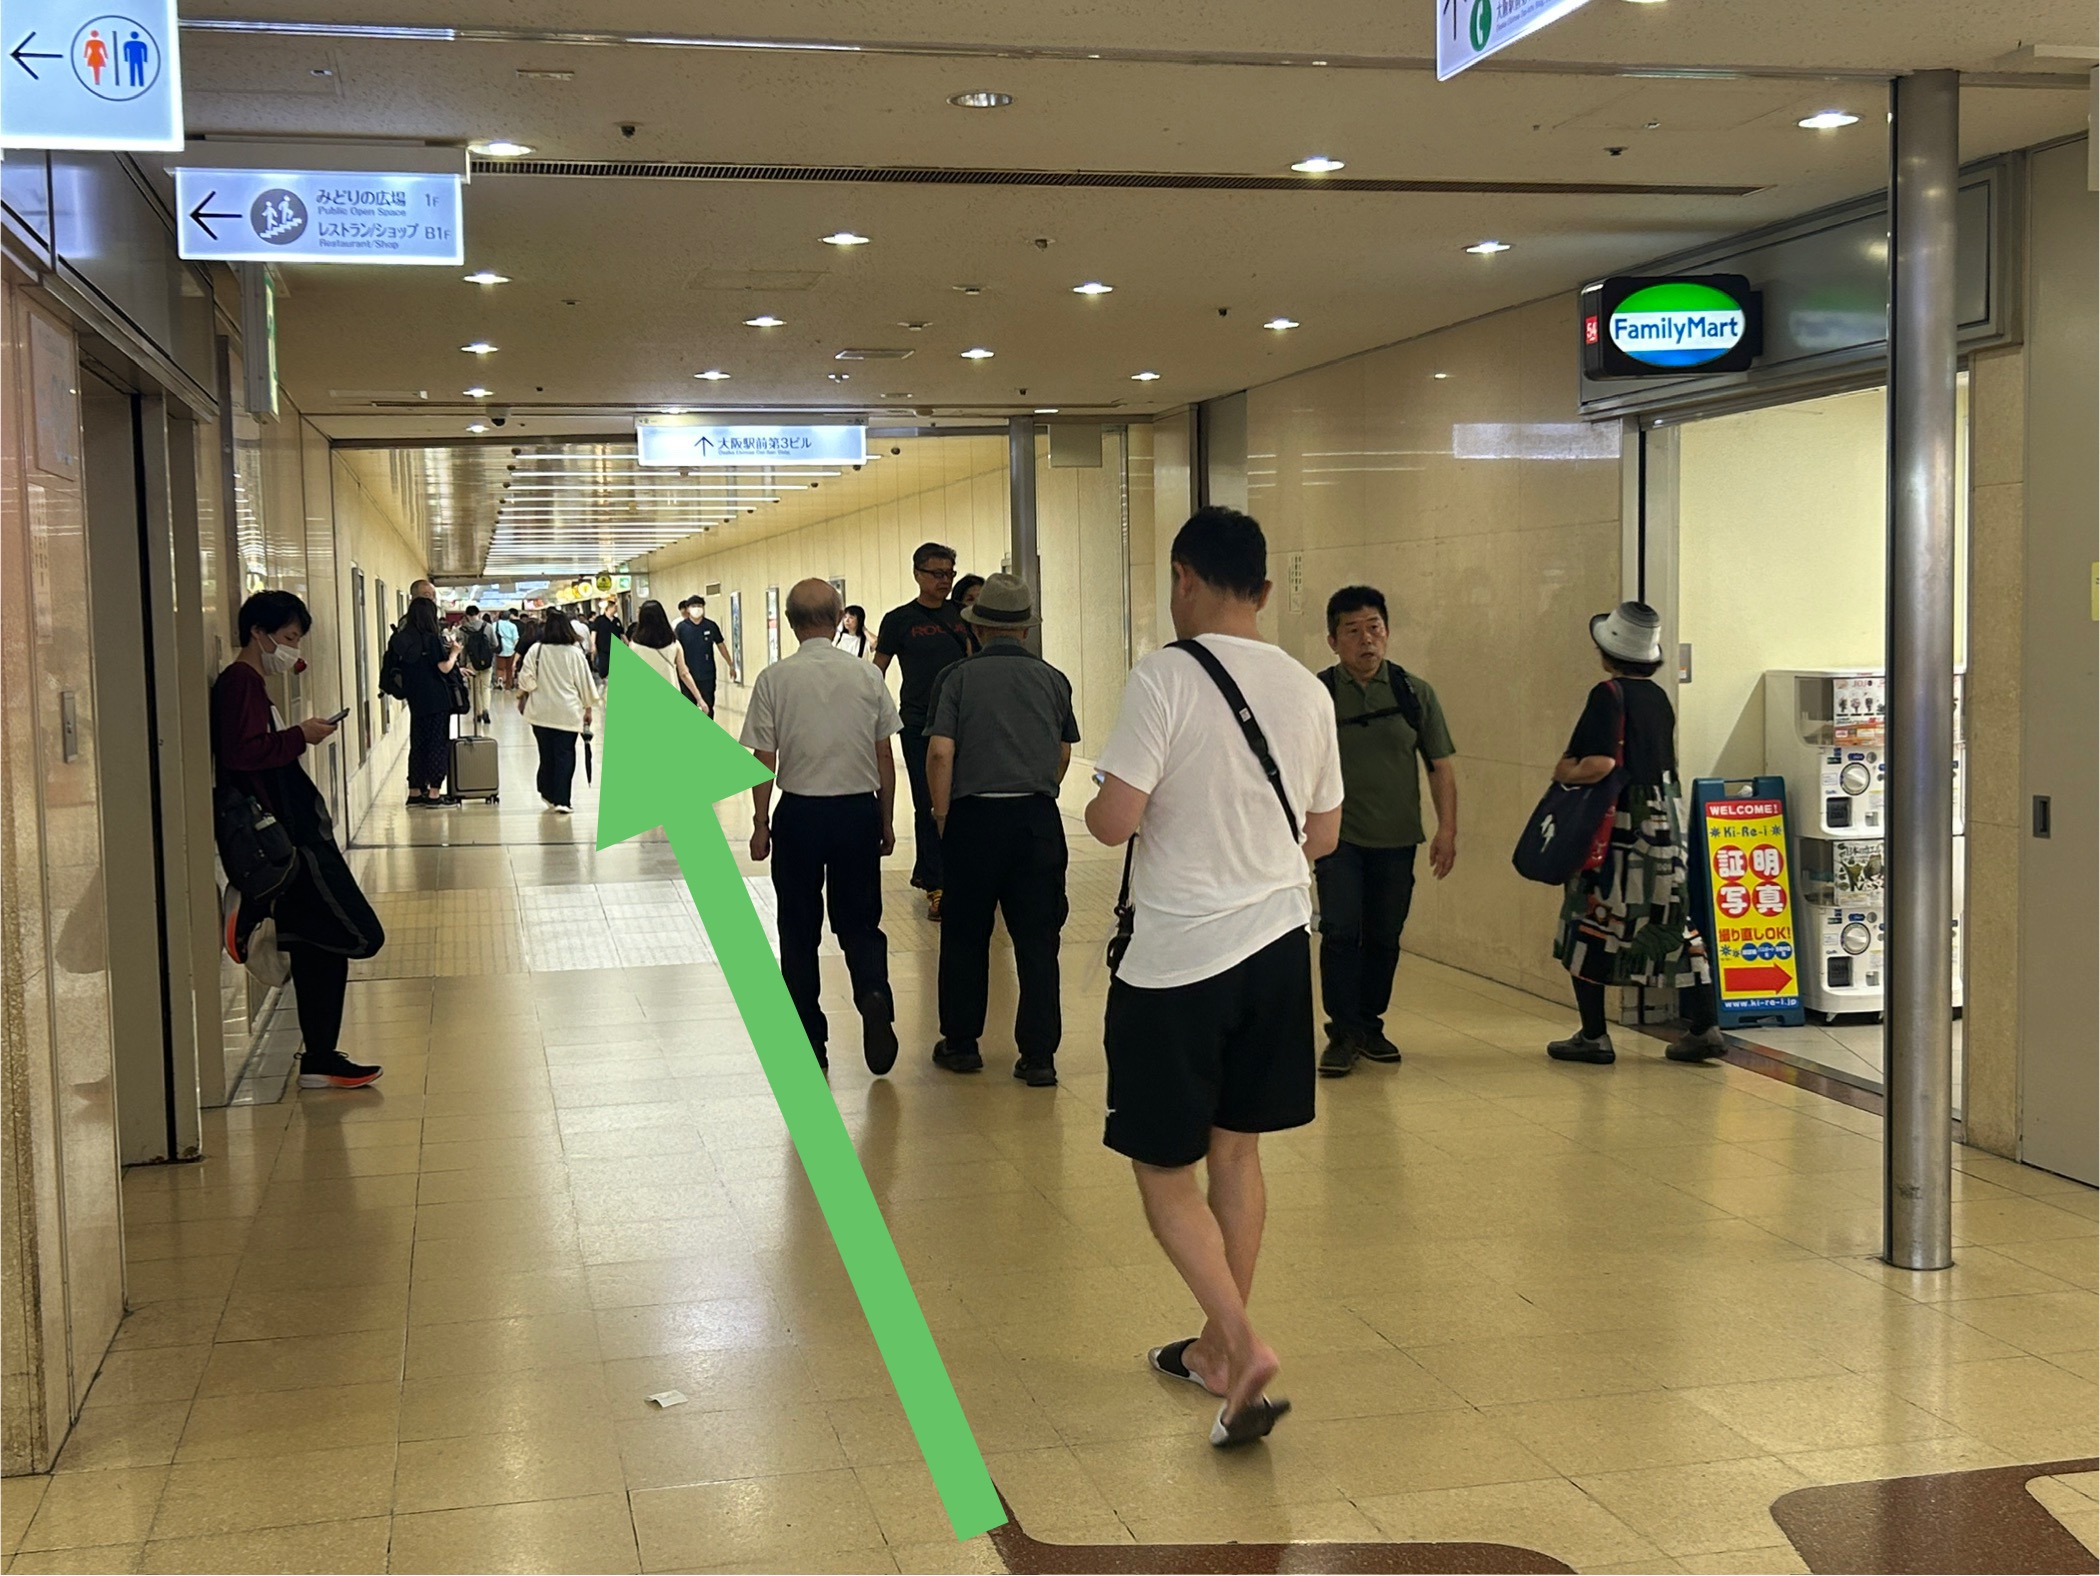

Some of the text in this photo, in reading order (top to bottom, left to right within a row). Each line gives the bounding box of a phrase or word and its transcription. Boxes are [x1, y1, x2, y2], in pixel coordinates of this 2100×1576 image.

[316, 189, 439, 207] みどりの広場 1F
[318, 206, 407, 217] Public Open Space
[425, 226, 451, 240] B1F
[1615, 317, 1738, 344] FamilyMart
[718, 437, 812, 449] 大阪駅前第3ビル
[1709, 804, 1779, 815] WELCOME!
[1723, 825, 1768, 837] Ki-Re-i
[1717, 848, 1782, 877] 証明
[1720, 884, 1784, 914] 写真
[1724, 998, 1797, 1008] www.ki-re-i.jp
